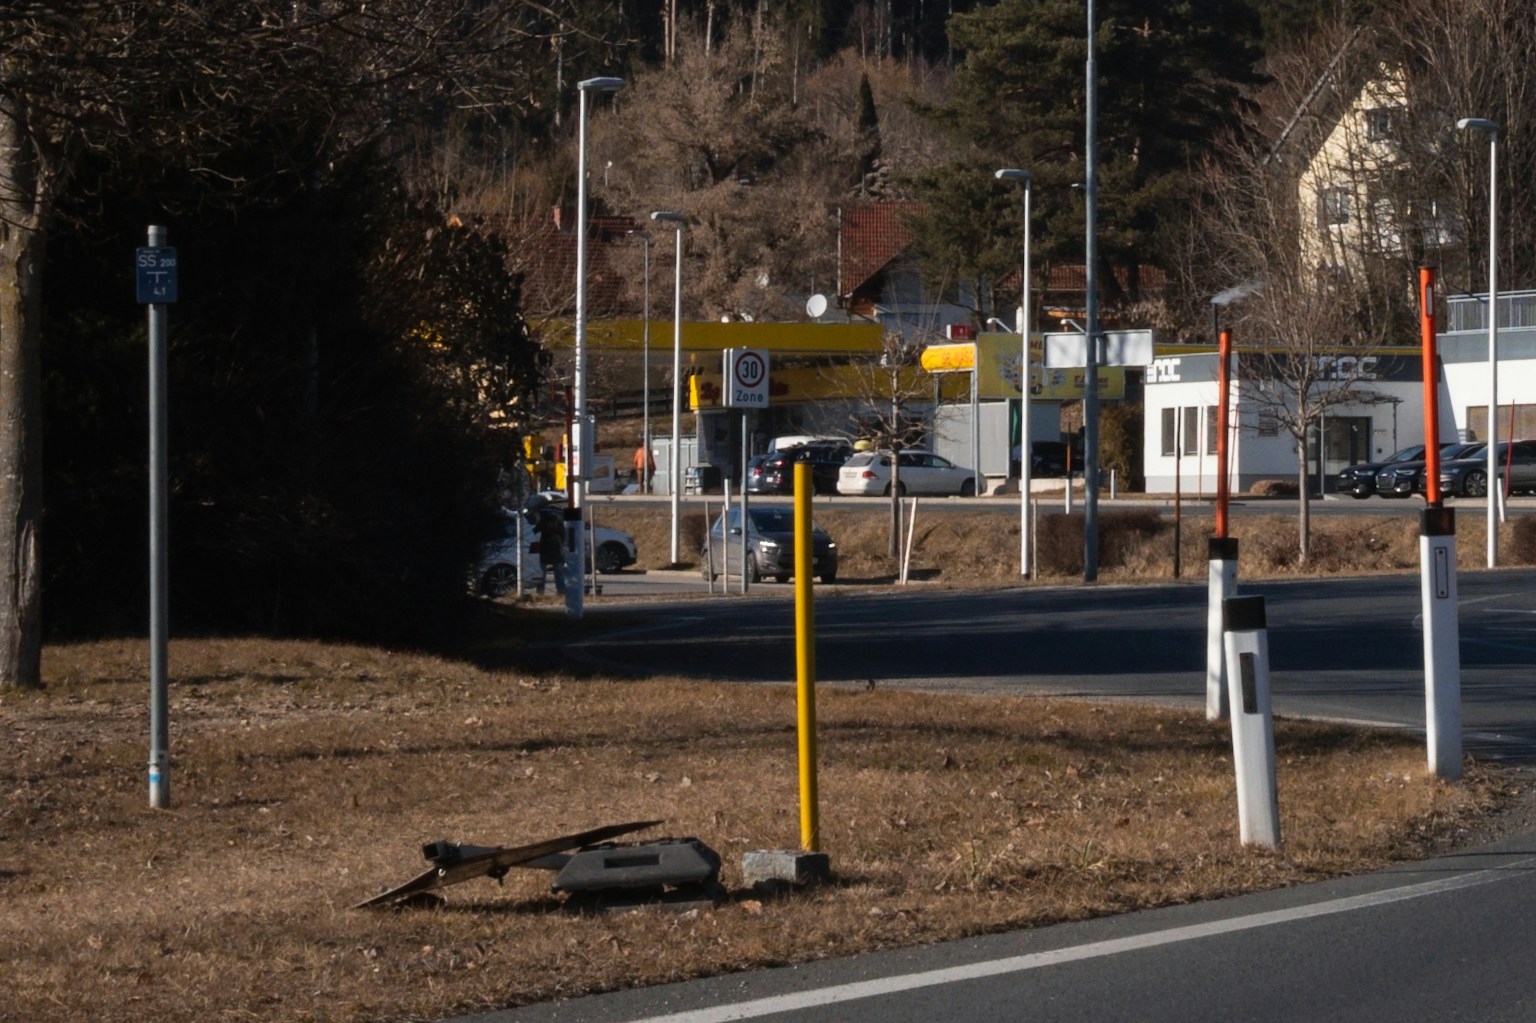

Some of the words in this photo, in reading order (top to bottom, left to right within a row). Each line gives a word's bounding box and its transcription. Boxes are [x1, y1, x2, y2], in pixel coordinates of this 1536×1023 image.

[138, 254, 157, 267] SS
[742, 361, 758, 379] 30
[736, 390, 764, 402] Zone
